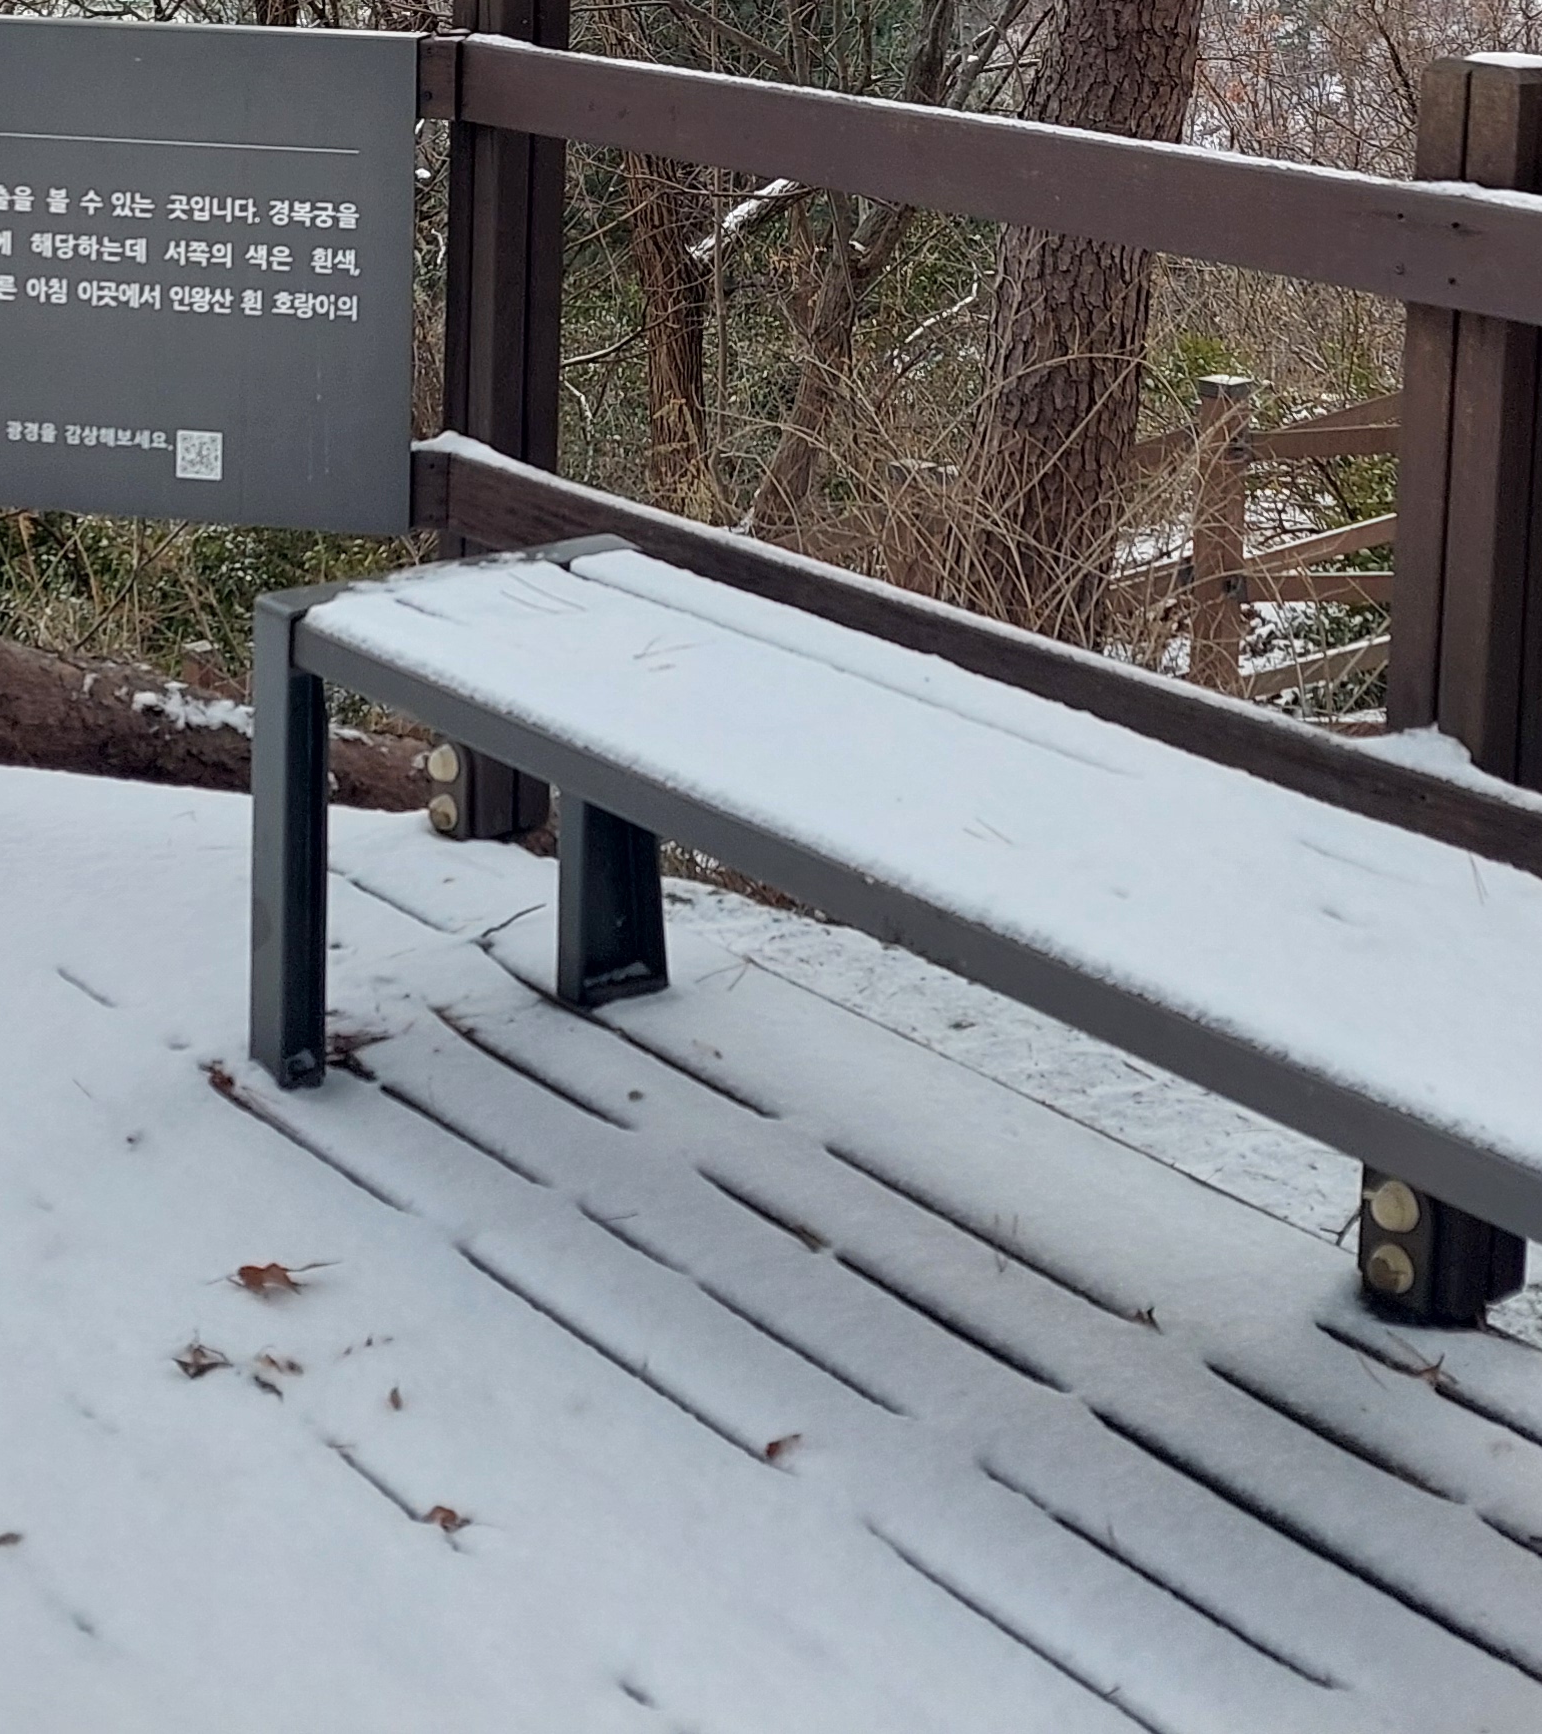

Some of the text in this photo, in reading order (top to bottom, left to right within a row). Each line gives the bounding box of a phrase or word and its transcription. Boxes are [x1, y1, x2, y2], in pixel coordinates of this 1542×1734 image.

[45, 187, 71, 214] 볼
[79, 189, 104, 216] 수
[110, 191, 156, 219] 있는
[166, 194, 261, 225] 곳입니다.
[268, 199, 360, 230] 경복궁을
[29, 232, 147, 264] 해당하는데
[163, 239, 233, 268] 서쪽의
[244, 244, 294, 272] 색은
[310, 247, 361, 277] 흰색,
[25, 276, 68, 304] 아침
[77, 280, 161, 310] 이곳에서
[169, 285, 234, 314] 인왕산
[240, 289, 263, 316] 흰
[271, 291, 359, 322] 호랑이의
[6, 420, 57, 443] 광경을
[64, 424, 174, 451] 감상해보세요.
